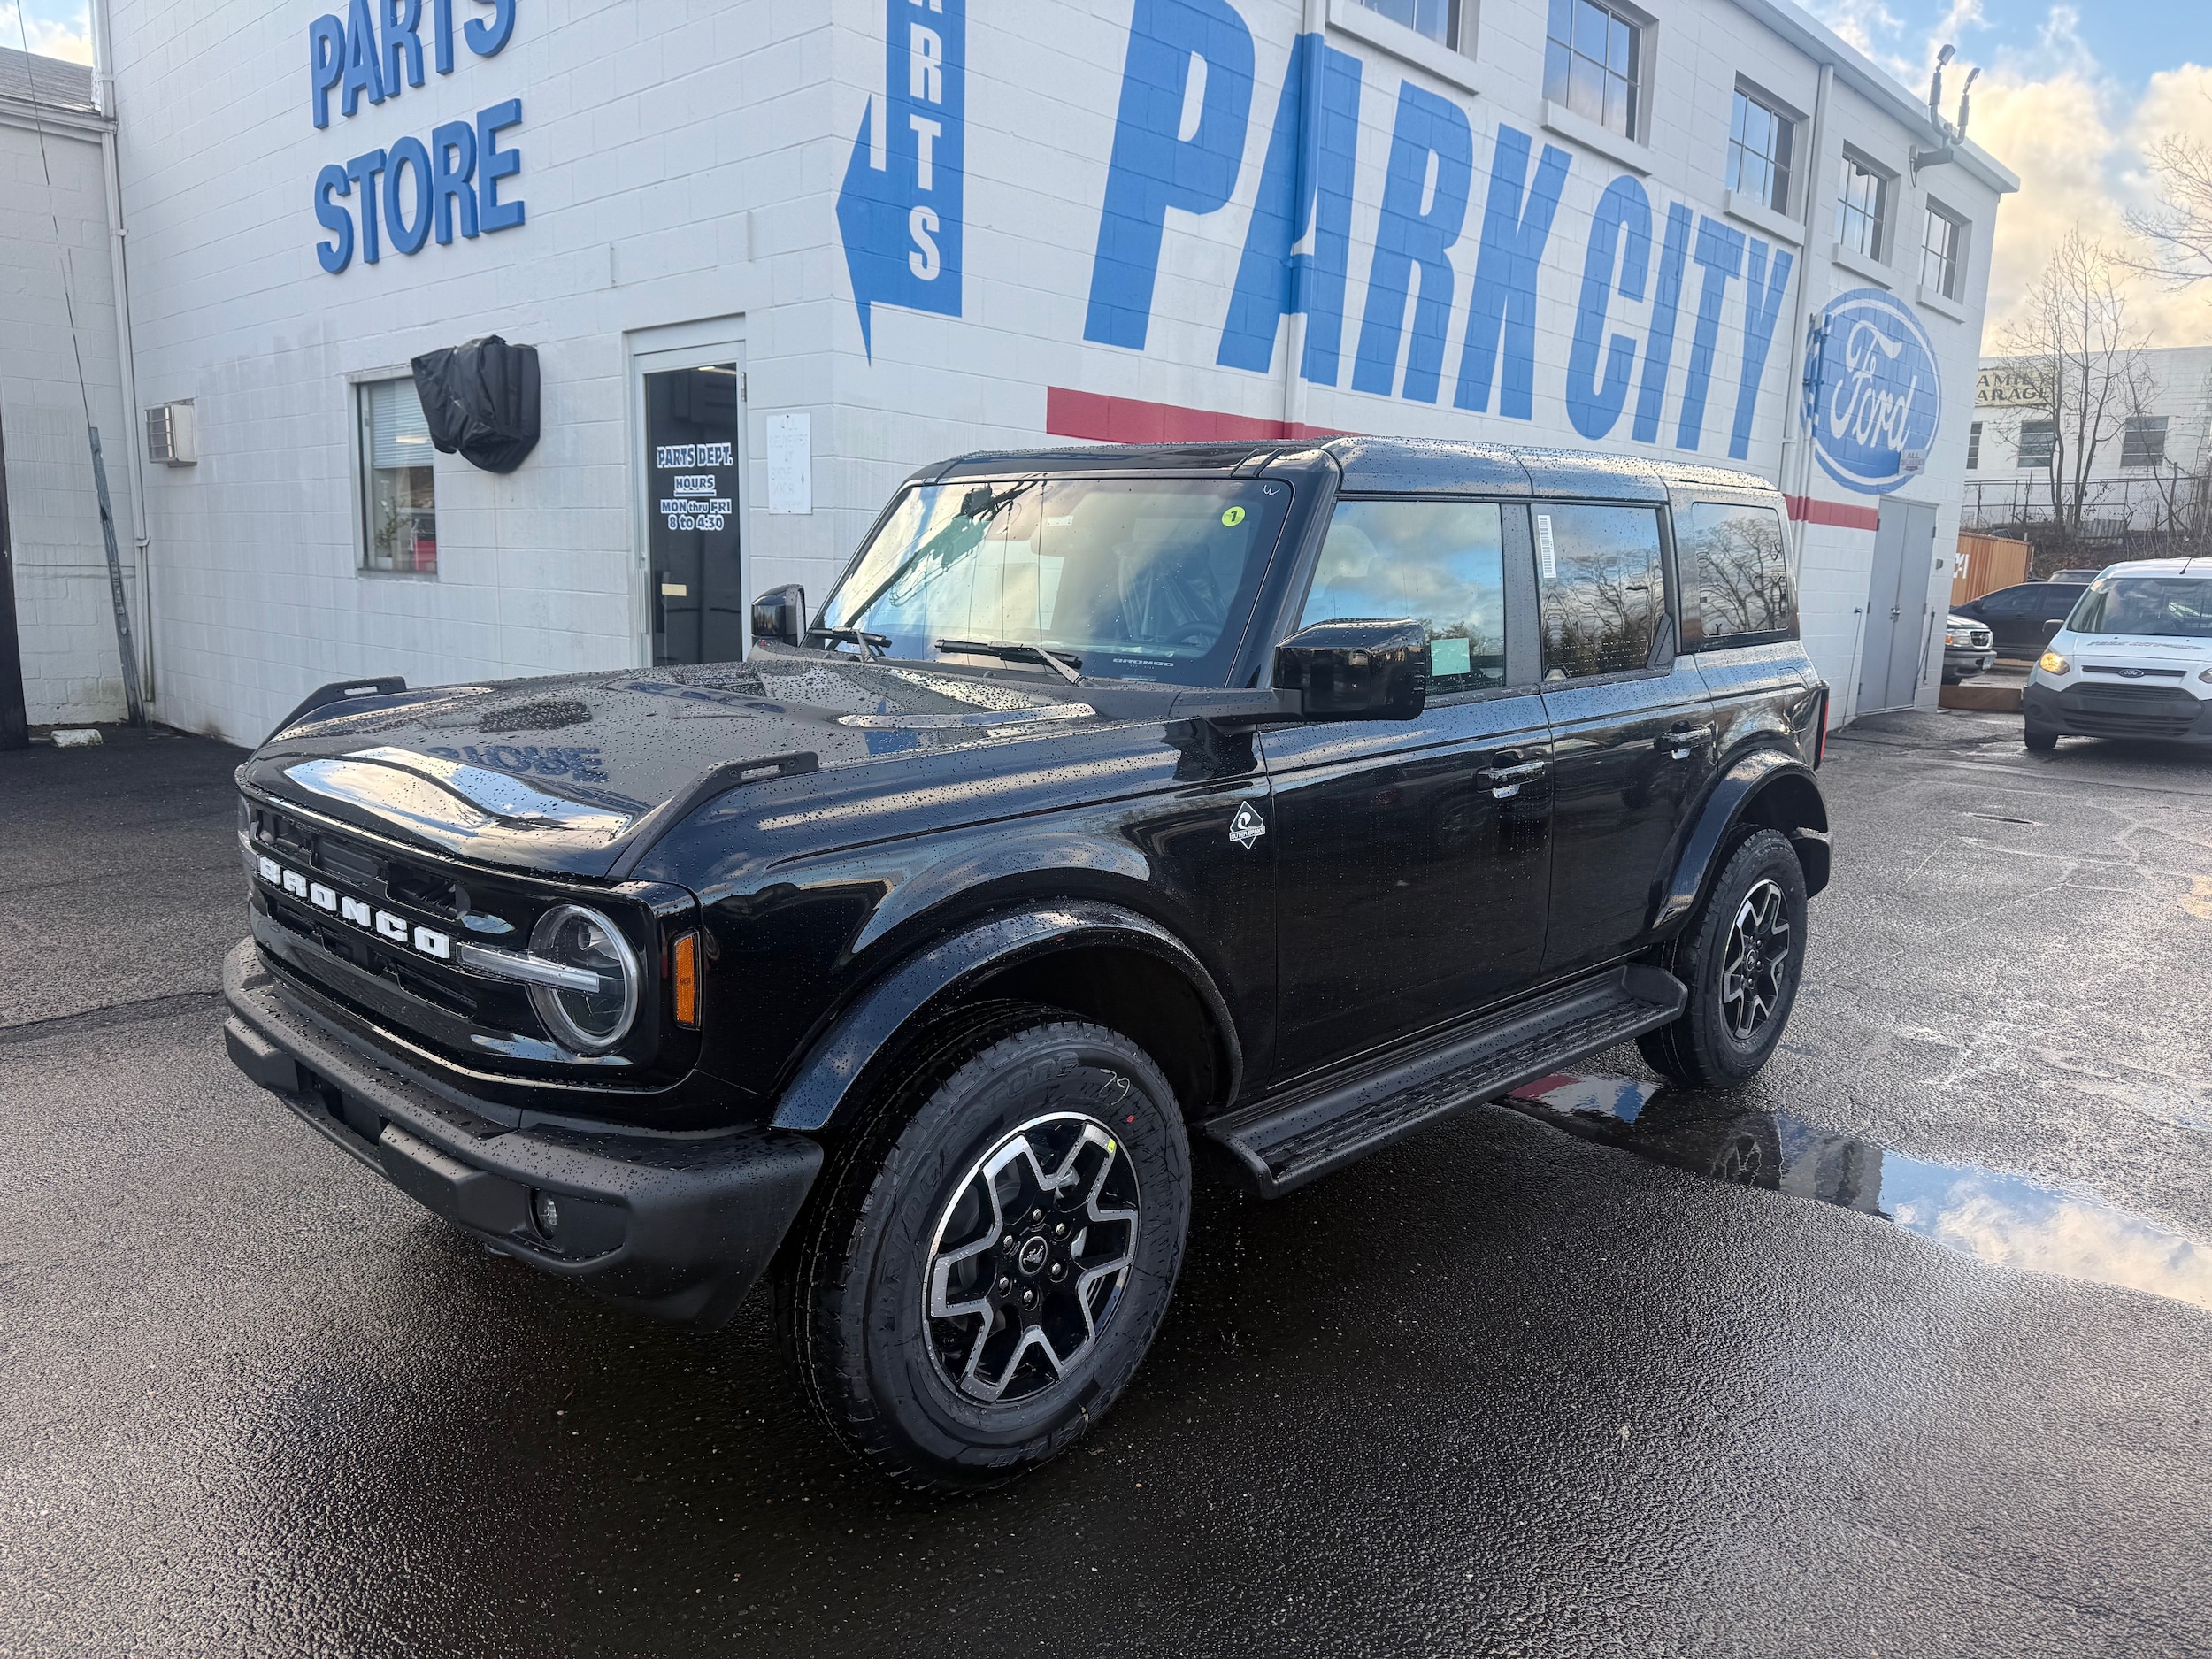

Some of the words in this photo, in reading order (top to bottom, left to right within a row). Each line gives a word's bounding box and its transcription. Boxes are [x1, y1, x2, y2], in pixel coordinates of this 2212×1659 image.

[908, 0, 942, 281] RTS
[314, 98, 526, 274] STORE
[1083, 0, 1572, 422] PARK
[1565, 174, 1793, 461] CITY
[1830, 319, 1918, 452] Ford
[657, 444, 695, 468] PARTS
[697, 442, 733, 466] DEPT.
[674, 474, 716, 490] HOURS
[660, 499, 687, 514] MON
[687, 500, 710, 513] thru
[709, 498, 732, 514] FRI
[668, 514, 677, 530] 8
[679, 515, 694, 530] to
[695, 514, 724, 531] 4:30
[1112, 657, 1175, 667] BRONCO
[258, 855, 450, 959] BRONCO
